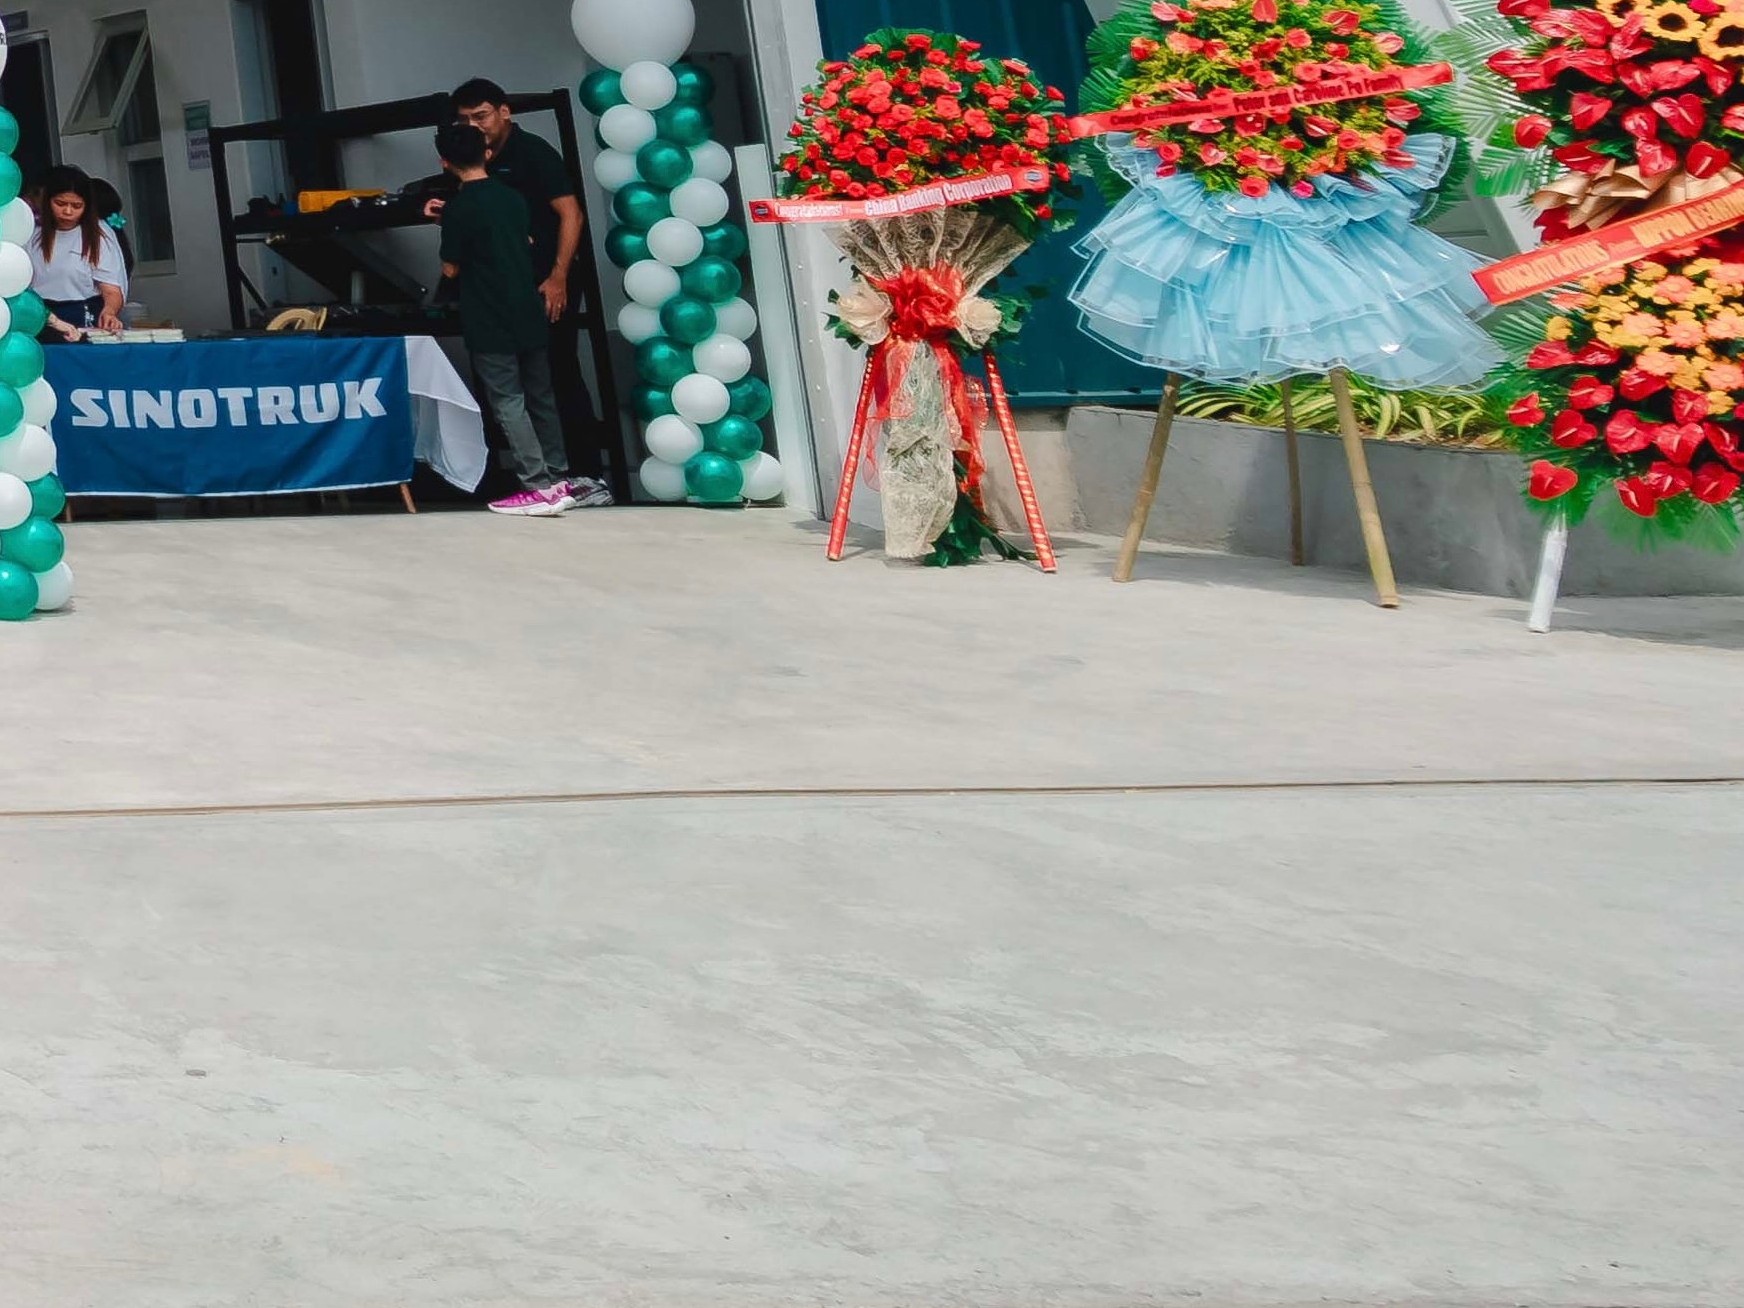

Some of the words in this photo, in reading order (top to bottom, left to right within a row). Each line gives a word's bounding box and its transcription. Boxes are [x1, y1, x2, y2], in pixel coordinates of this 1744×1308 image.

[1294, 81, 1345, 105] Caroline
[864, 197, 898, 216] China
[898, 187, 946, 213] Banking
[942, 172, 1013, 203] Corporation
[69, 376, 387, 429] SINOTRUK
